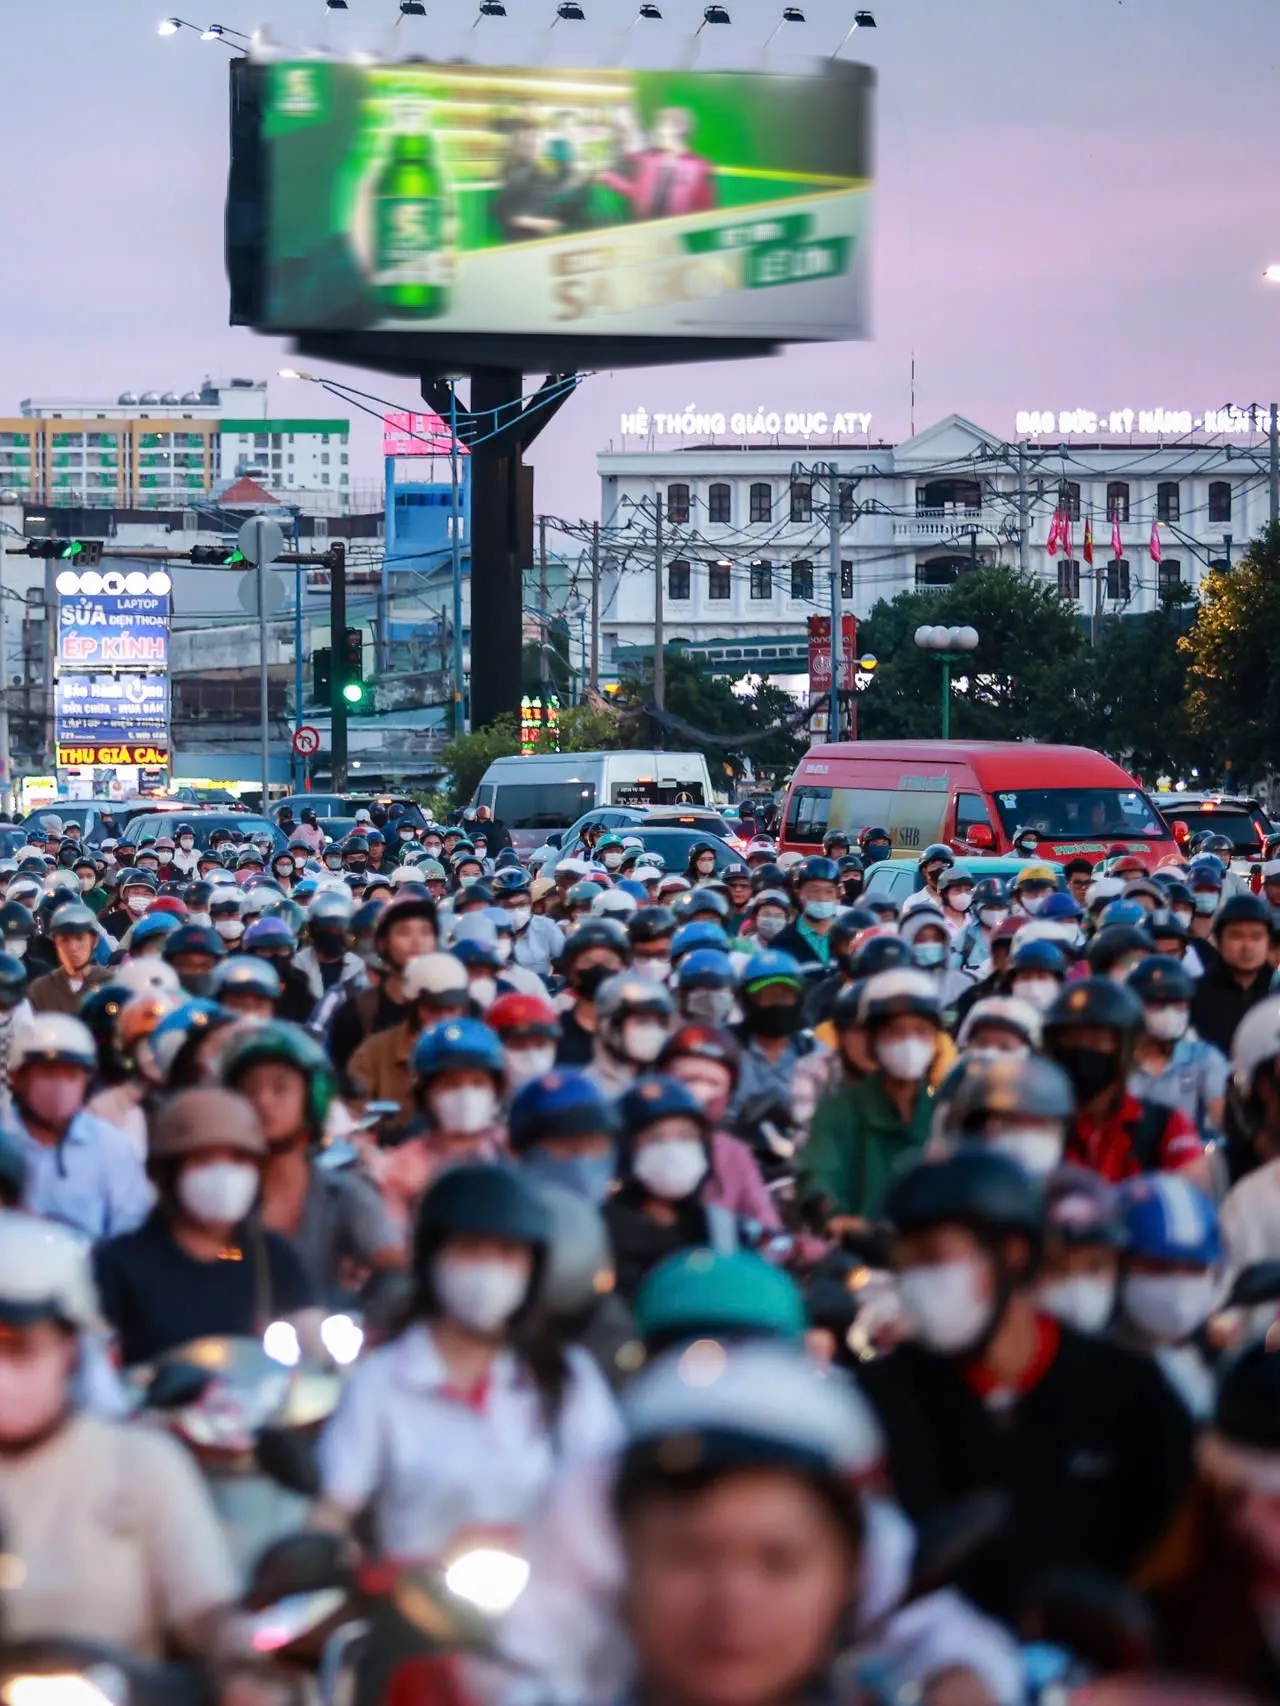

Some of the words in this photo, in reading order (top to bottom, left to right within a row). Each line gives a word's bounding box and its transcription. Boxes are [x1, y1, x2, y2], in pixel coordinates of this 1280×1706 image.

[621, 407, 649, 439] HỆ
[653, 403, 726, 435] THỐNG
[730, 406, 781, 435] GIÁO
[784, 412, 828, 440] DỤC
[832, 412, 872, 434] ATY
[61, 597, 107, 626] SỬA
[117, 599, 159, 609] LAPTOP
[63, 630, 98, 659] ÉP
[101, 631, 165, 659] KÍNH
[61, 748, 94, 764] THU
[98, 745, 132, 764] GIÁ
[898, 826, 920, 847] SHB
